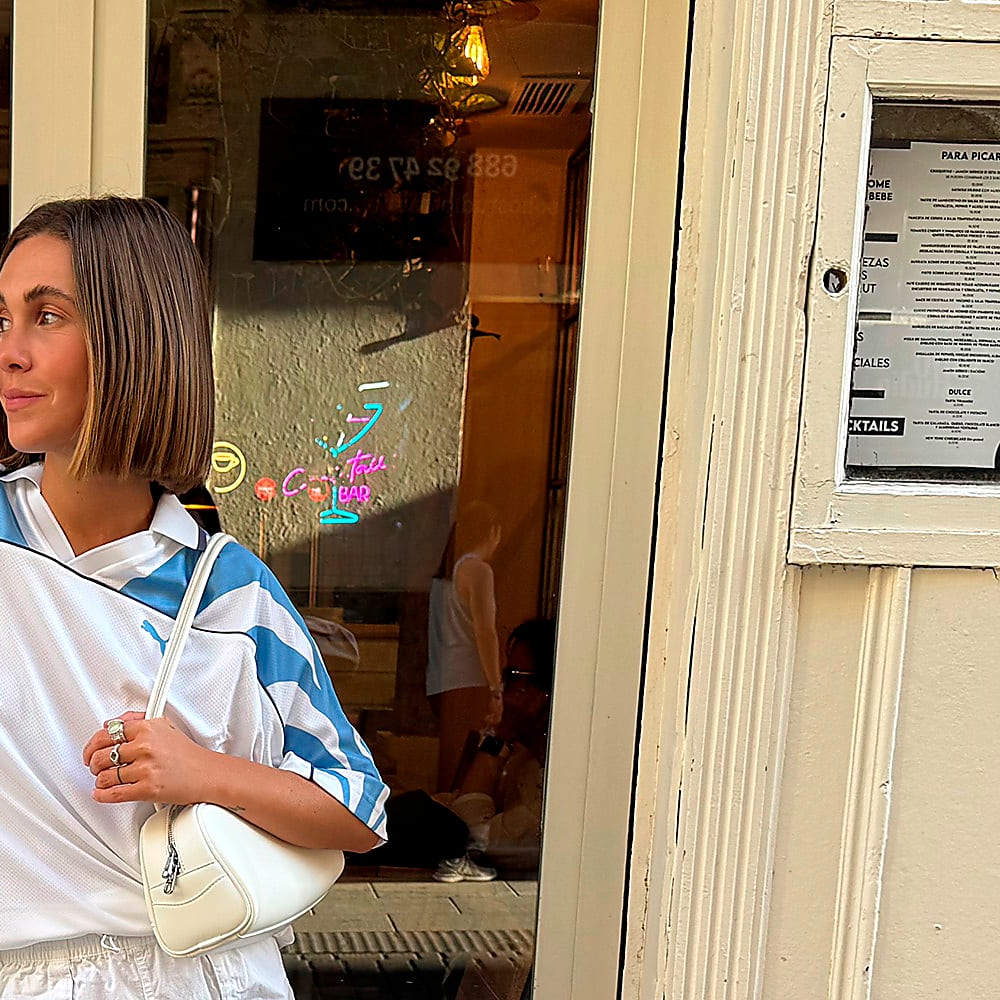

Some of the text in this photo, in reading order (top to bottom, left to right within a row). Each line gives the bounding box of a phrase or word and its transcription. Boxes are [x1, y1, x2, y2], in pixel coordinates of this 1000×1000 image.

[941, 151, 1000, 161] PARA PICAR
[868, 191, 893, 201] BEBE
[948, 388, 971, 396] DULCE
[338, 484, 371, 504] BAR
